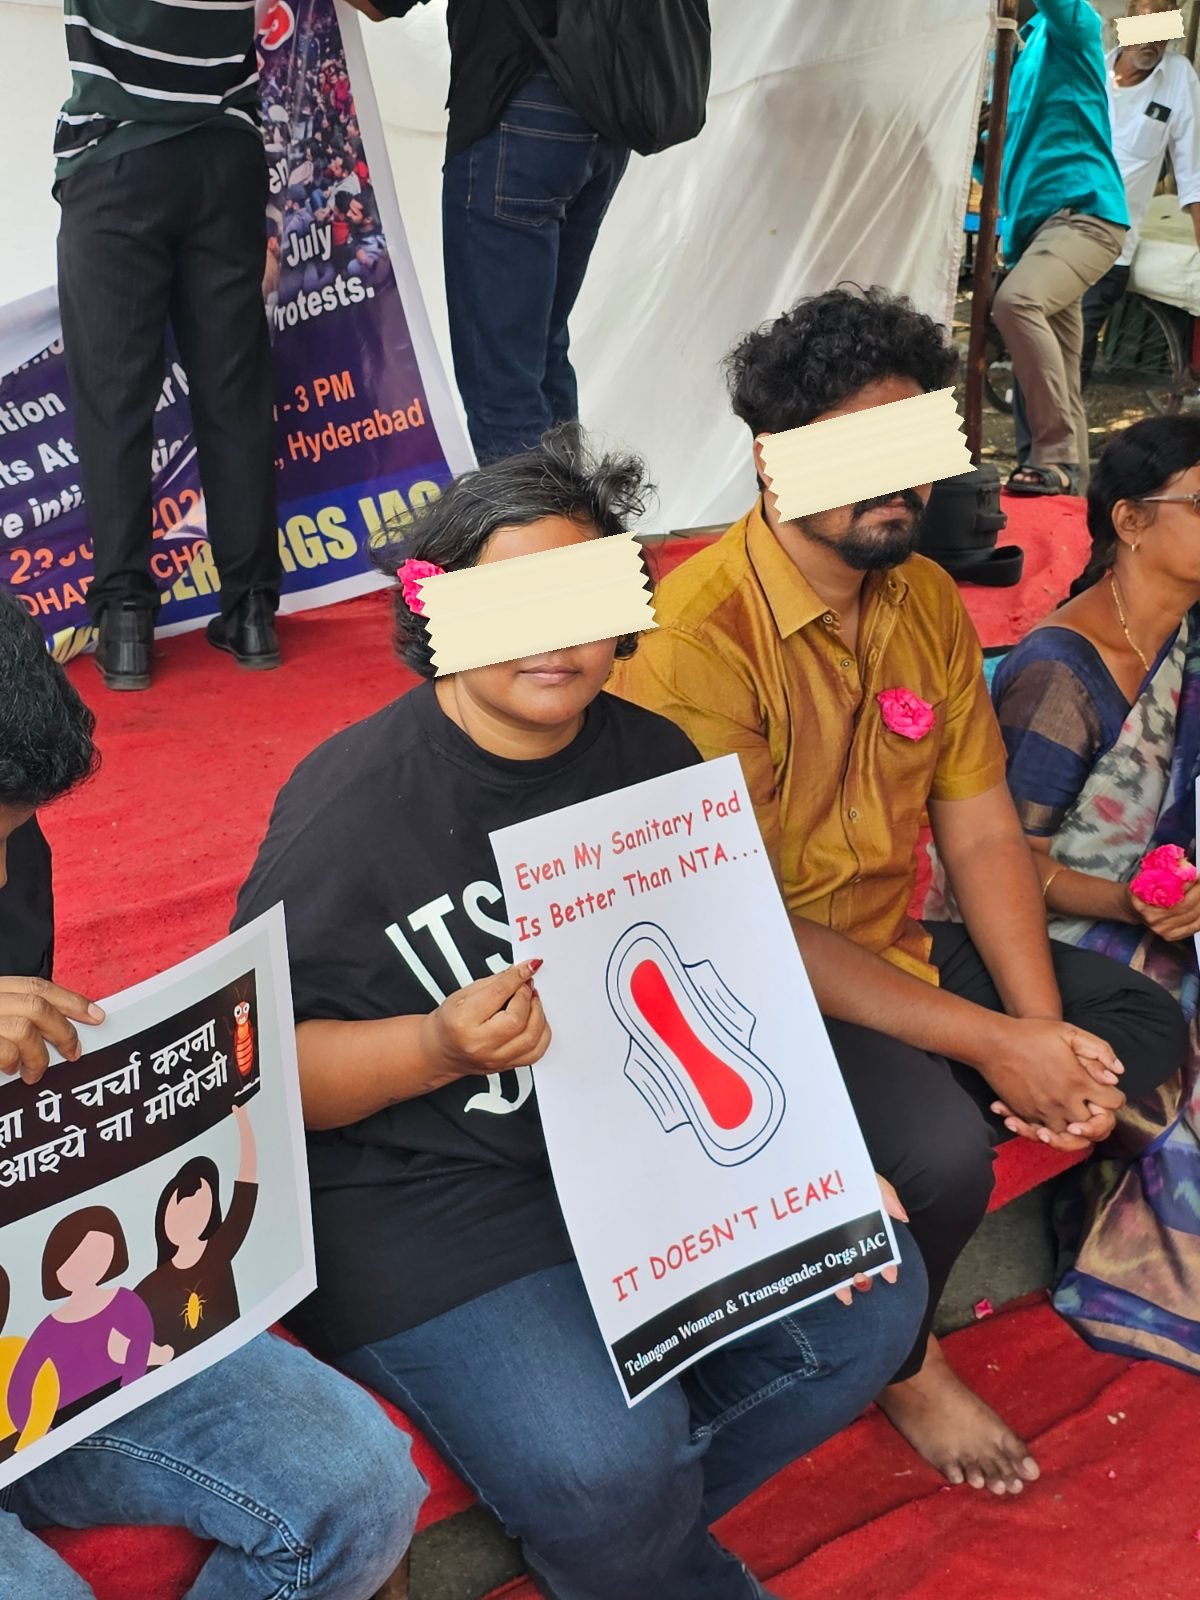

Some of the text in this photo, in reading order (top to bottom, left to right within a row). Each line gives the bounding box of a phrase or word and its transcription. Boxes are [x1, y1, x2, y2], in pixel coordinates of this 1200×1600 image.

[286, 223, 332, 267] July
[274, 273, 375, 332] rotests.
[0, 392, 66, 435] tion
[294, 384, 310, 413] 3
[313, 370, 356, 407] PM
[287, 397, 426, 463] Hyderabad
[0, 459, 35, 490] ts
[37, 437, 80, 473] At
[514, 790, 742, 891] Even My Sanitary Pad
[515, 842, 758, 942] Is Better Than NTA...
[36, 1018, 216, 1123] पे चर्चा करना
[96, 1108, 133, 1142] ना
[612, 1169, 846, 1302] IT DOESN'T LEAK!
[625, 1231, 887, 1376] Telangana Women & Transgender Orgs JAC
